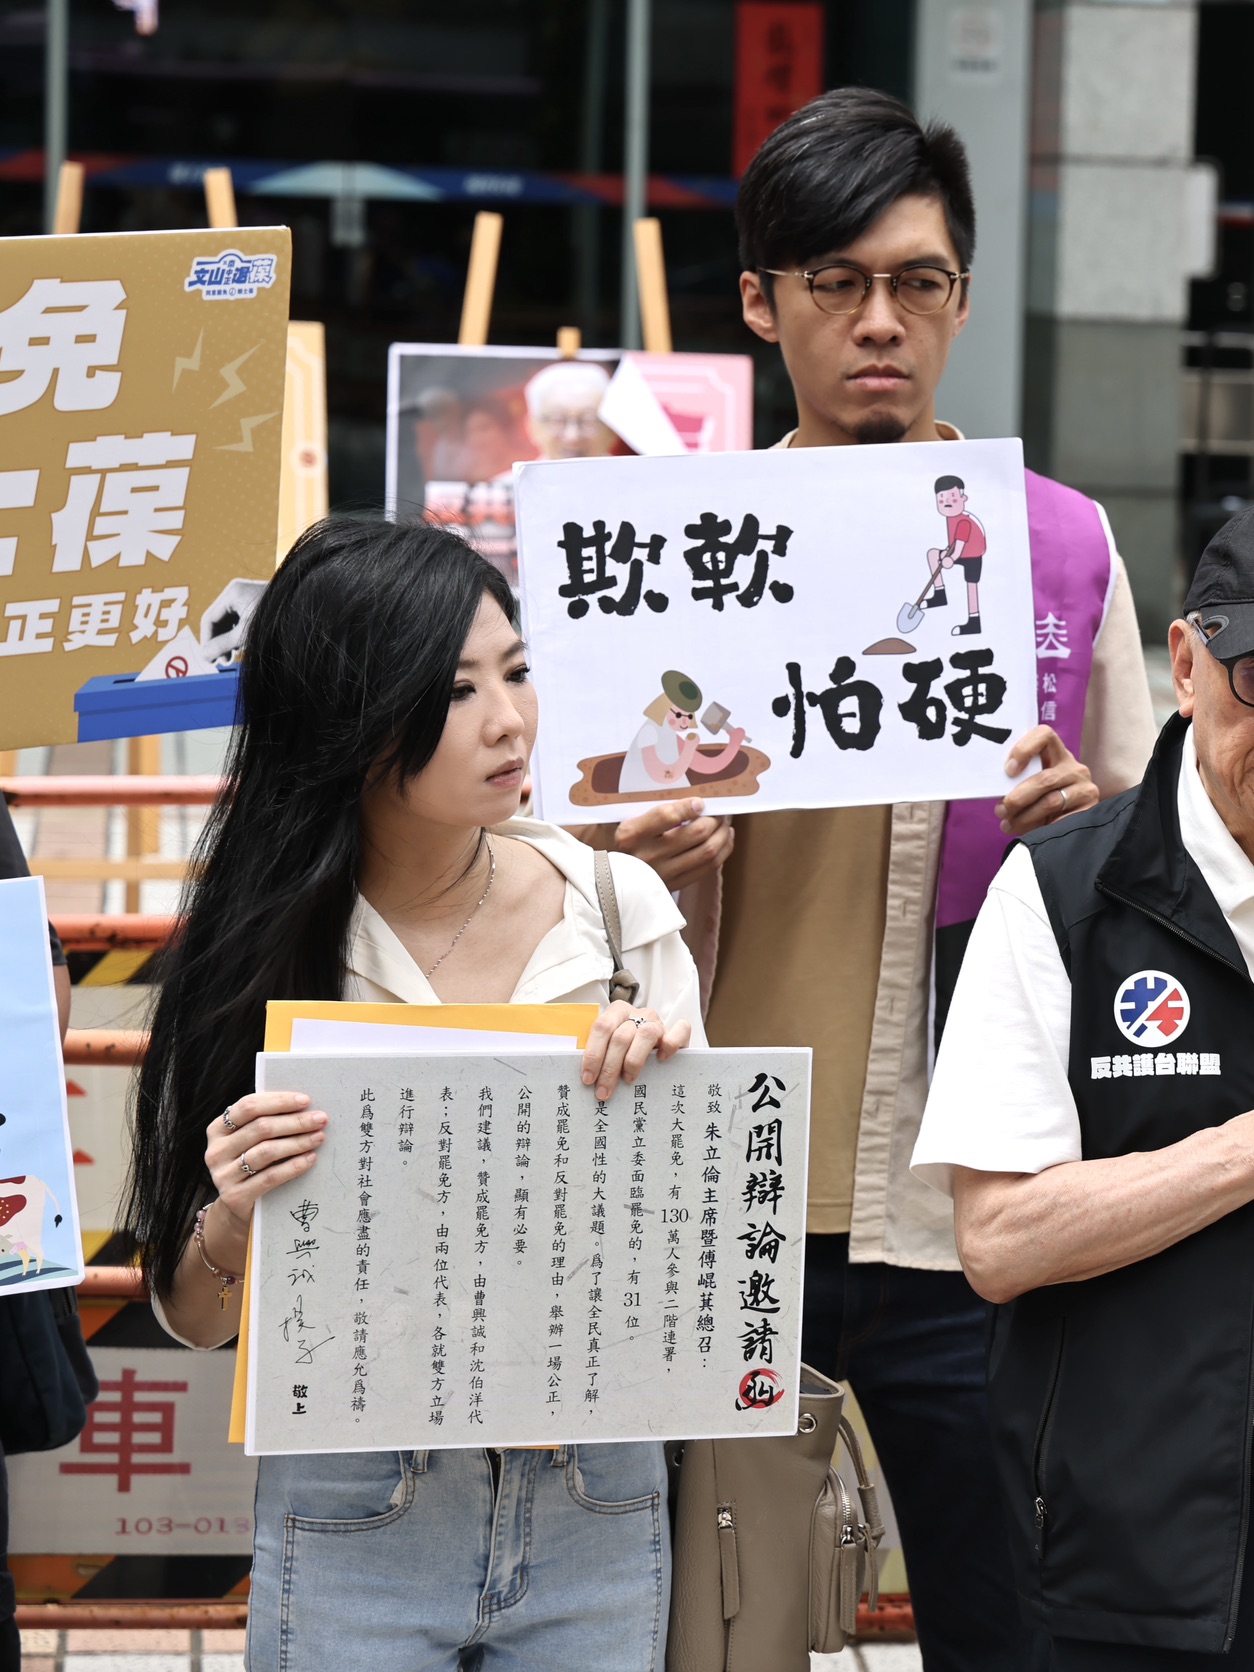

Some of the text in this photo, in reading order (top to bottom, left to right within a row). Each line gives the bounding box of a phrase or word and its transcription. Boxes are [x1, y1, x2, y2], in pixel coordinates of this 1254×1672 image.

[0, 278, 128, 415] 免
[0, 432, 198, 577] 葆
[556, 511, 796, 620] 欺軟
[0, 586, 191, 657] 正更好
[771, 648, 1012, 759] 怕硬
[1090, 1052, 1222, 1080] 反共護台聯盟
[660, 1208, 689, 1224] 130
[623, 1292, 642, 1307] 31
[59, 1368, 191, 1493] 車
[291, 1384, 308, 1415] 敬上
